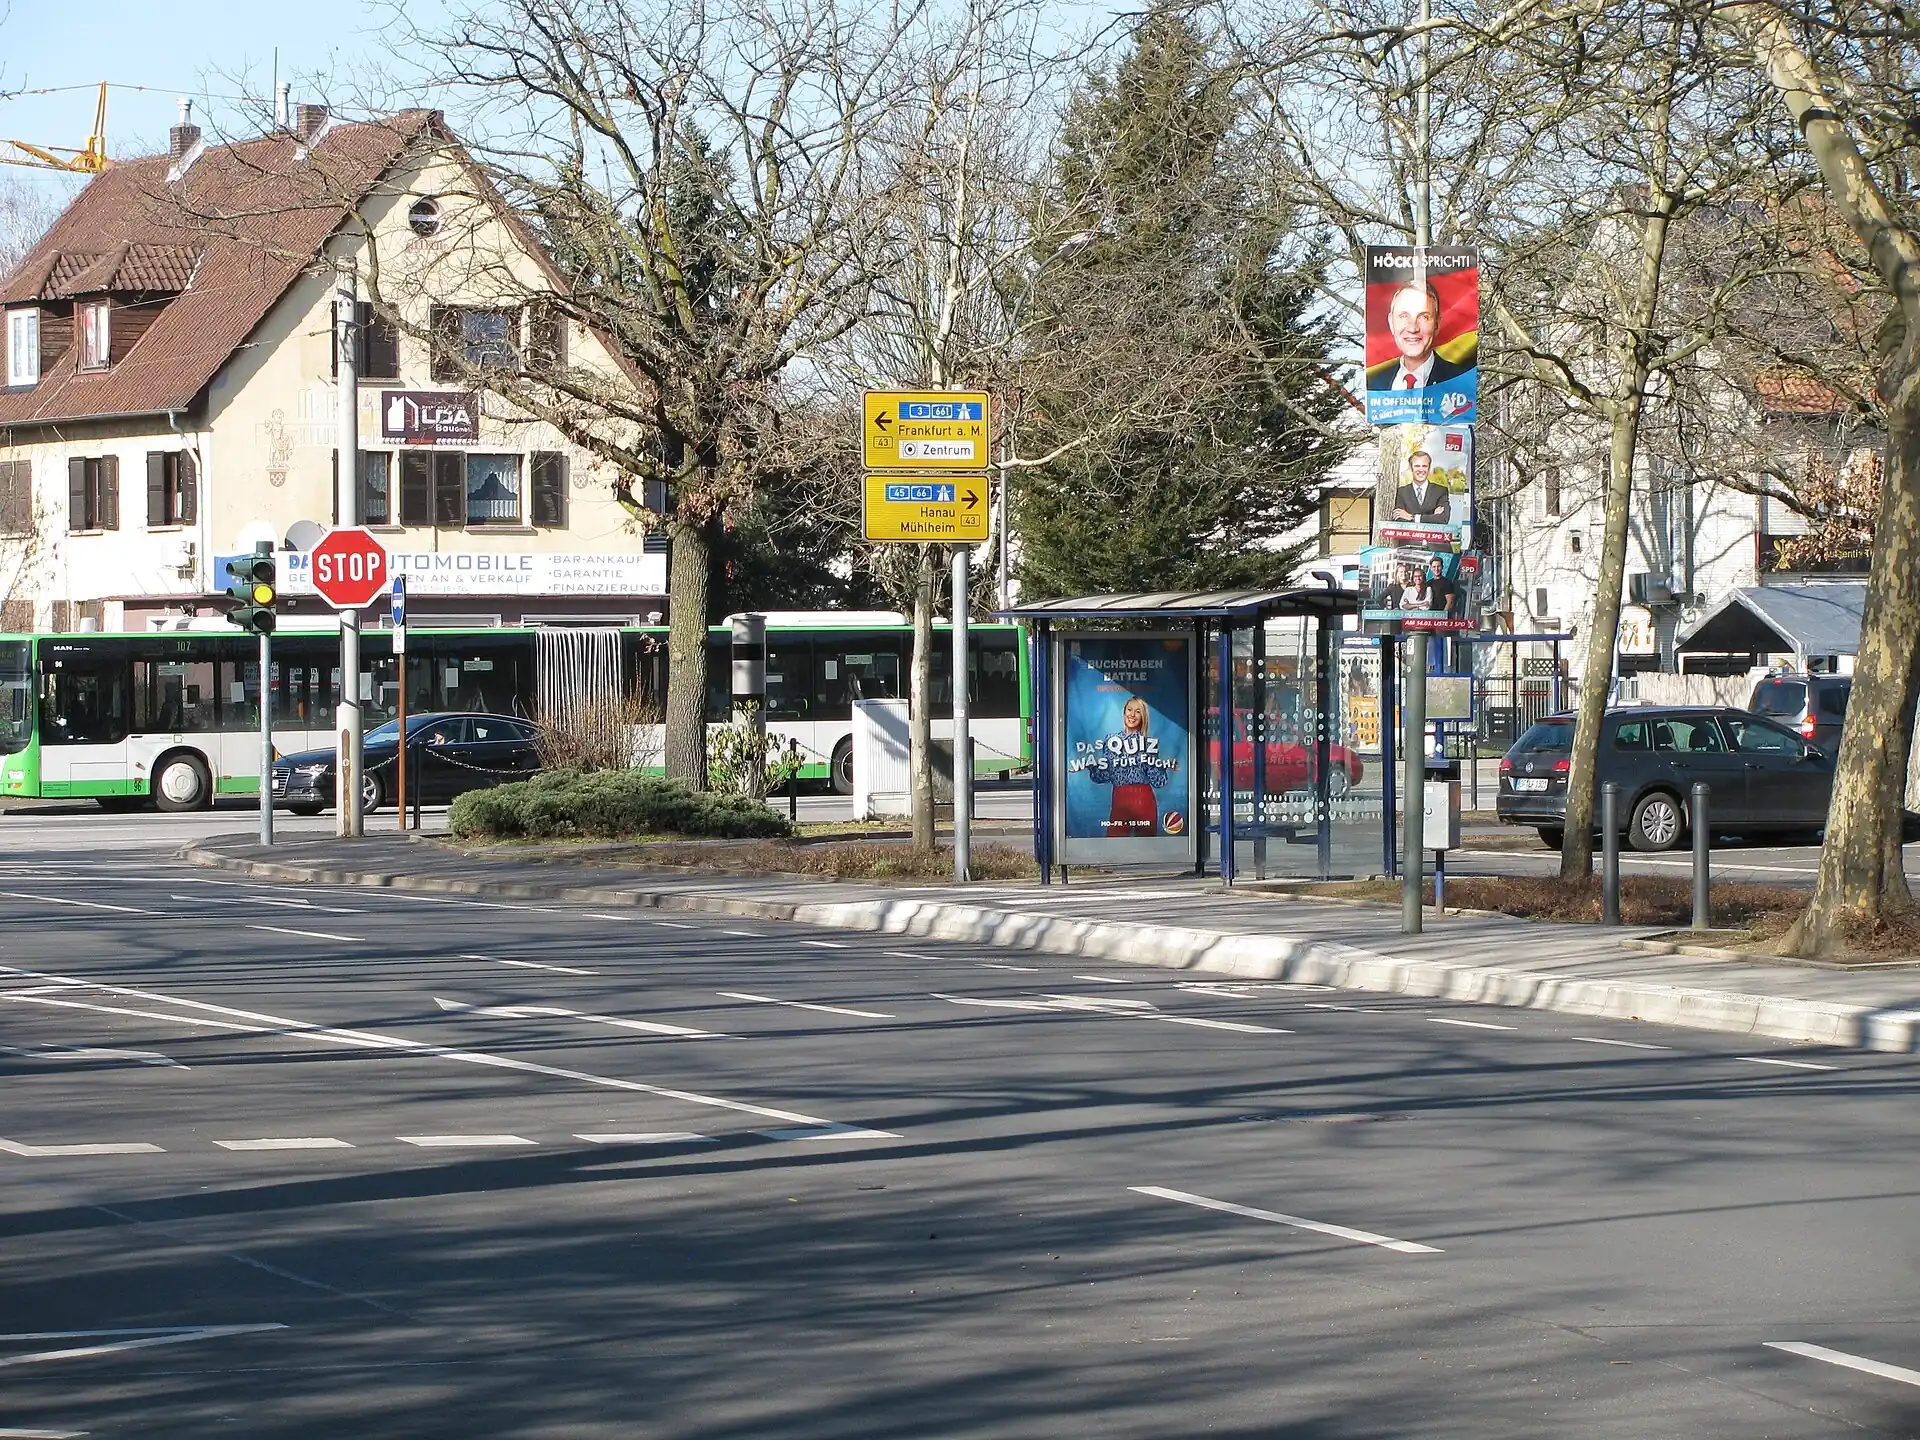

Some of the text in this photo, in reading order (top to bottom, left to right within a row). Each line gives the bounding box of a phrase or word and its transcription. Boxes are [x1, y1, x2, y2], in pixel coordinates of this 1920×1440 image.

[1440, 392, 1467, 406] AfD
[935, 407, 949, 416] 661
[898, 425, 983, 436] Frankfurt a. M.
[878, 439, 889, 447] 43
[923, 445, 971, 455] Zentrum
[894, 489, 927, 497] 45 66
[920, 507, 956, 517] Hanau
[965, 517, 976, 525] 43
[900, 522, 956, 533] Mühlheim
[553, 555, 644, 564] BAR-ANKAUF
[318, 552, 381, 582] STOP
[430, 574, 449, 583] AN
[455, 574, 465, 583] &
[470, 574, 533, 583] VERKAUF
[553, 569, 624, 578] GARANTIE
[553, 583, 660, 592] FINANZIERUNG
[177, 640, 191, 651] 107
[1087, 659, 1163, 669] BUCHSTABEN
[1103, 672, 1147, 681] BATTLE
[1075, 736, 1159, 755] DAS QUIZ
[1070, 754, 1109, 772] WAS
[1112, 754, 1137, 767] FÜR
